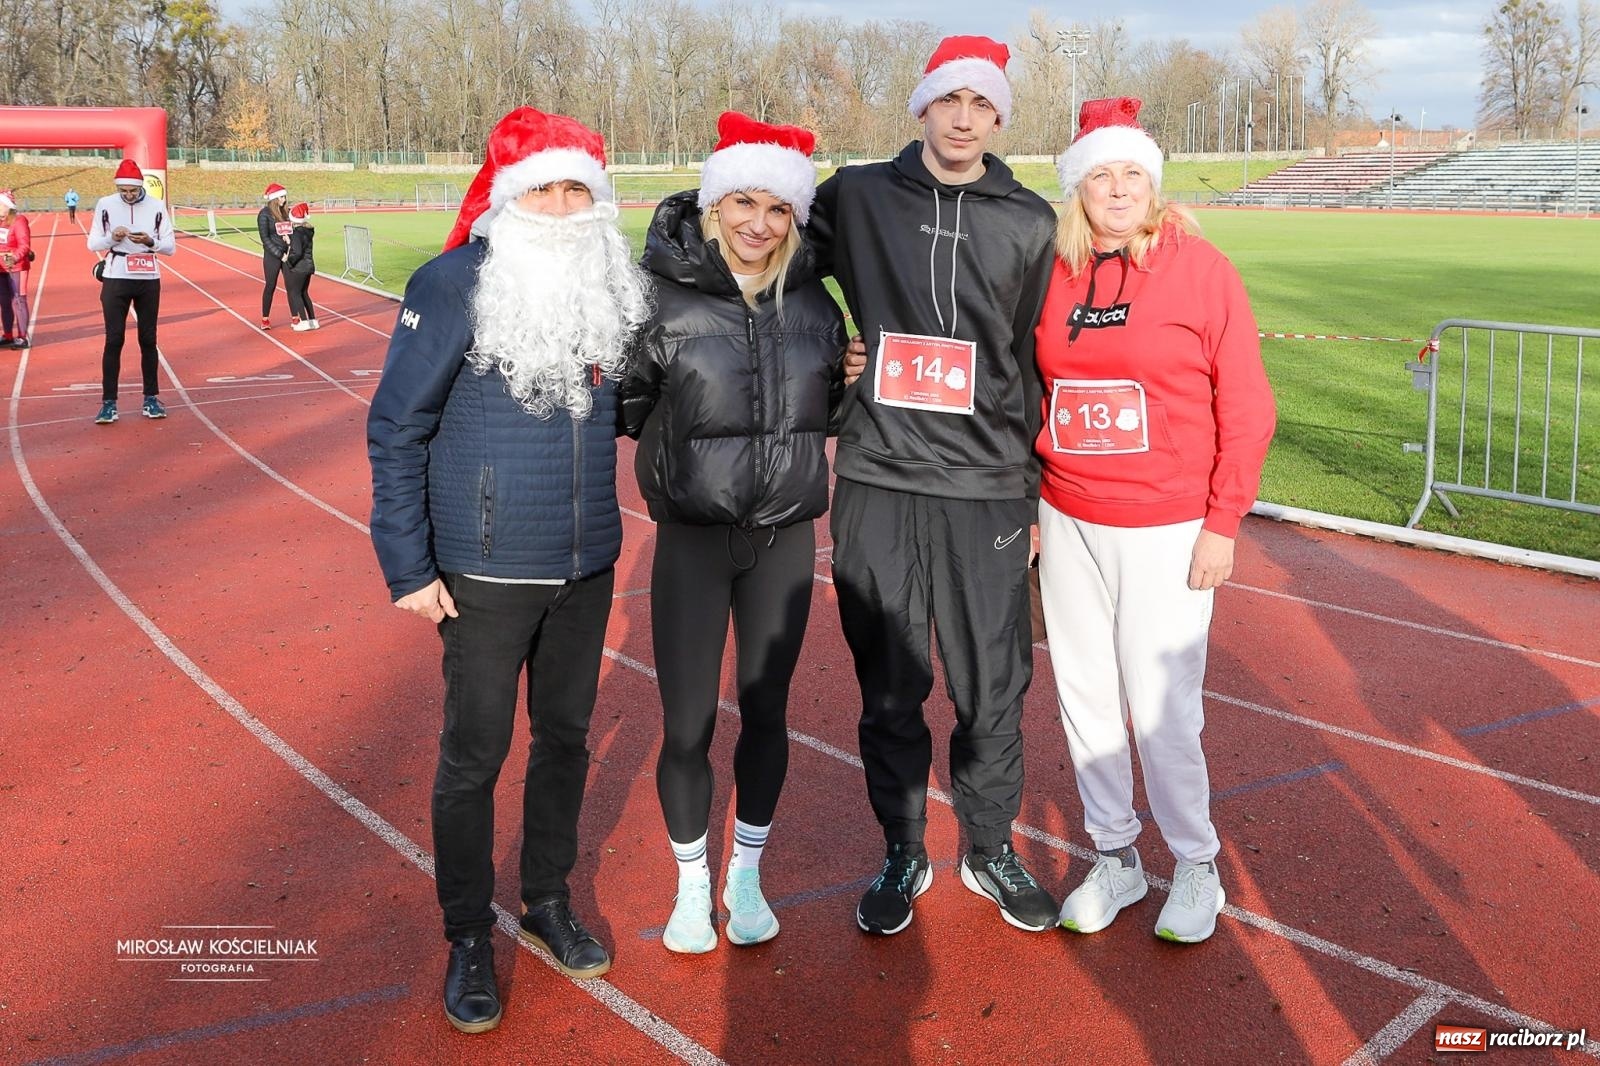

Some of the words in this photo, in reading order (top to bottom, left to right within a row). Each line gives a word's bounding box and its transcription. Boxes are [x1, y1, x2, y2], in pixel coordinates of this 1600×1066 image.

[135, 257, 147, 267] 70
[401, 308, 420, 330] HH
[911, 355, 944, 384] 14
[1077, 403, 1112, 430] 13
